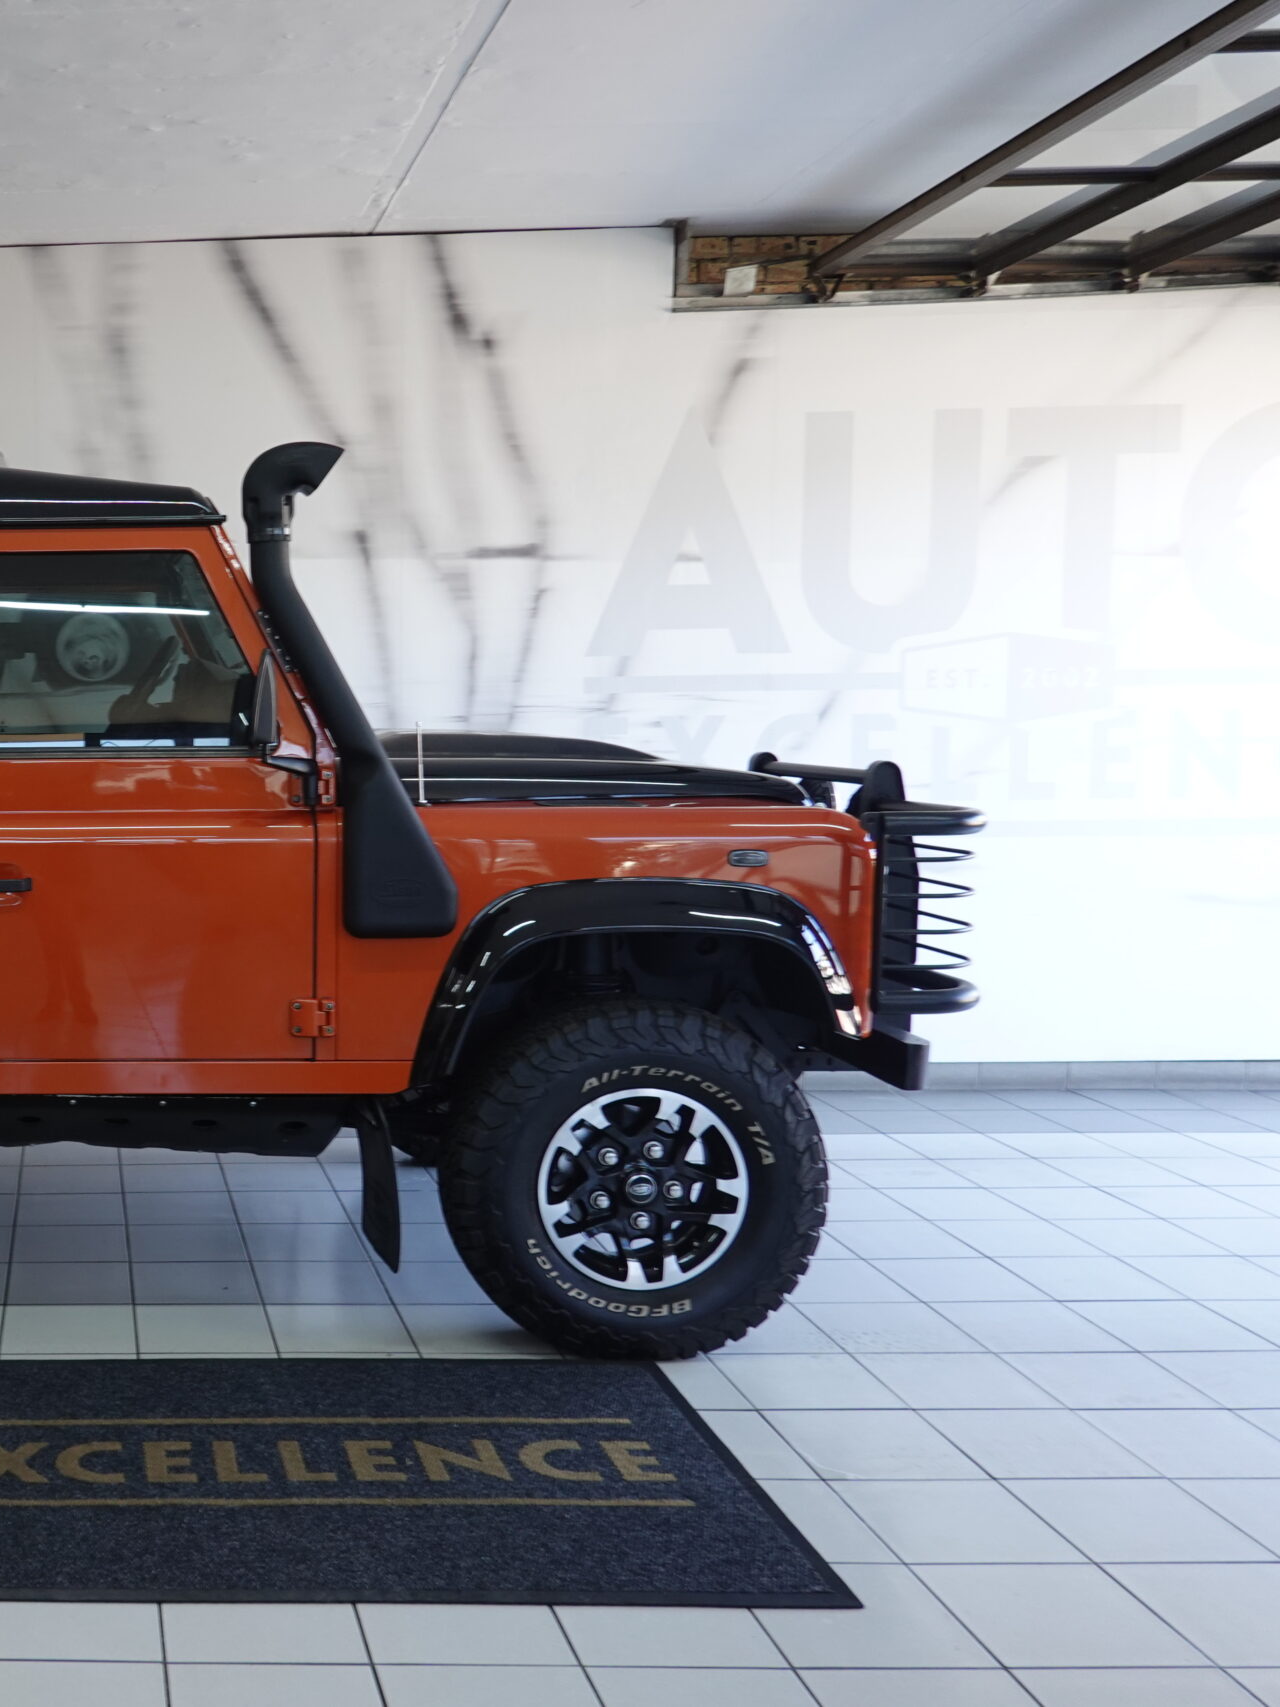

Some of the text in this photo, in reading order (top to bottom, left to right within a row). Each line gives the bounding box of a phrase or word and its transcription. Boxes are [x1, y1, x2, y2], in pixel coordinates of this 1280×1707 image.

[581, 1065, 776, 1166] All-Terrain T/A
[525, 1238, 694, 1318] BFGoodrich
